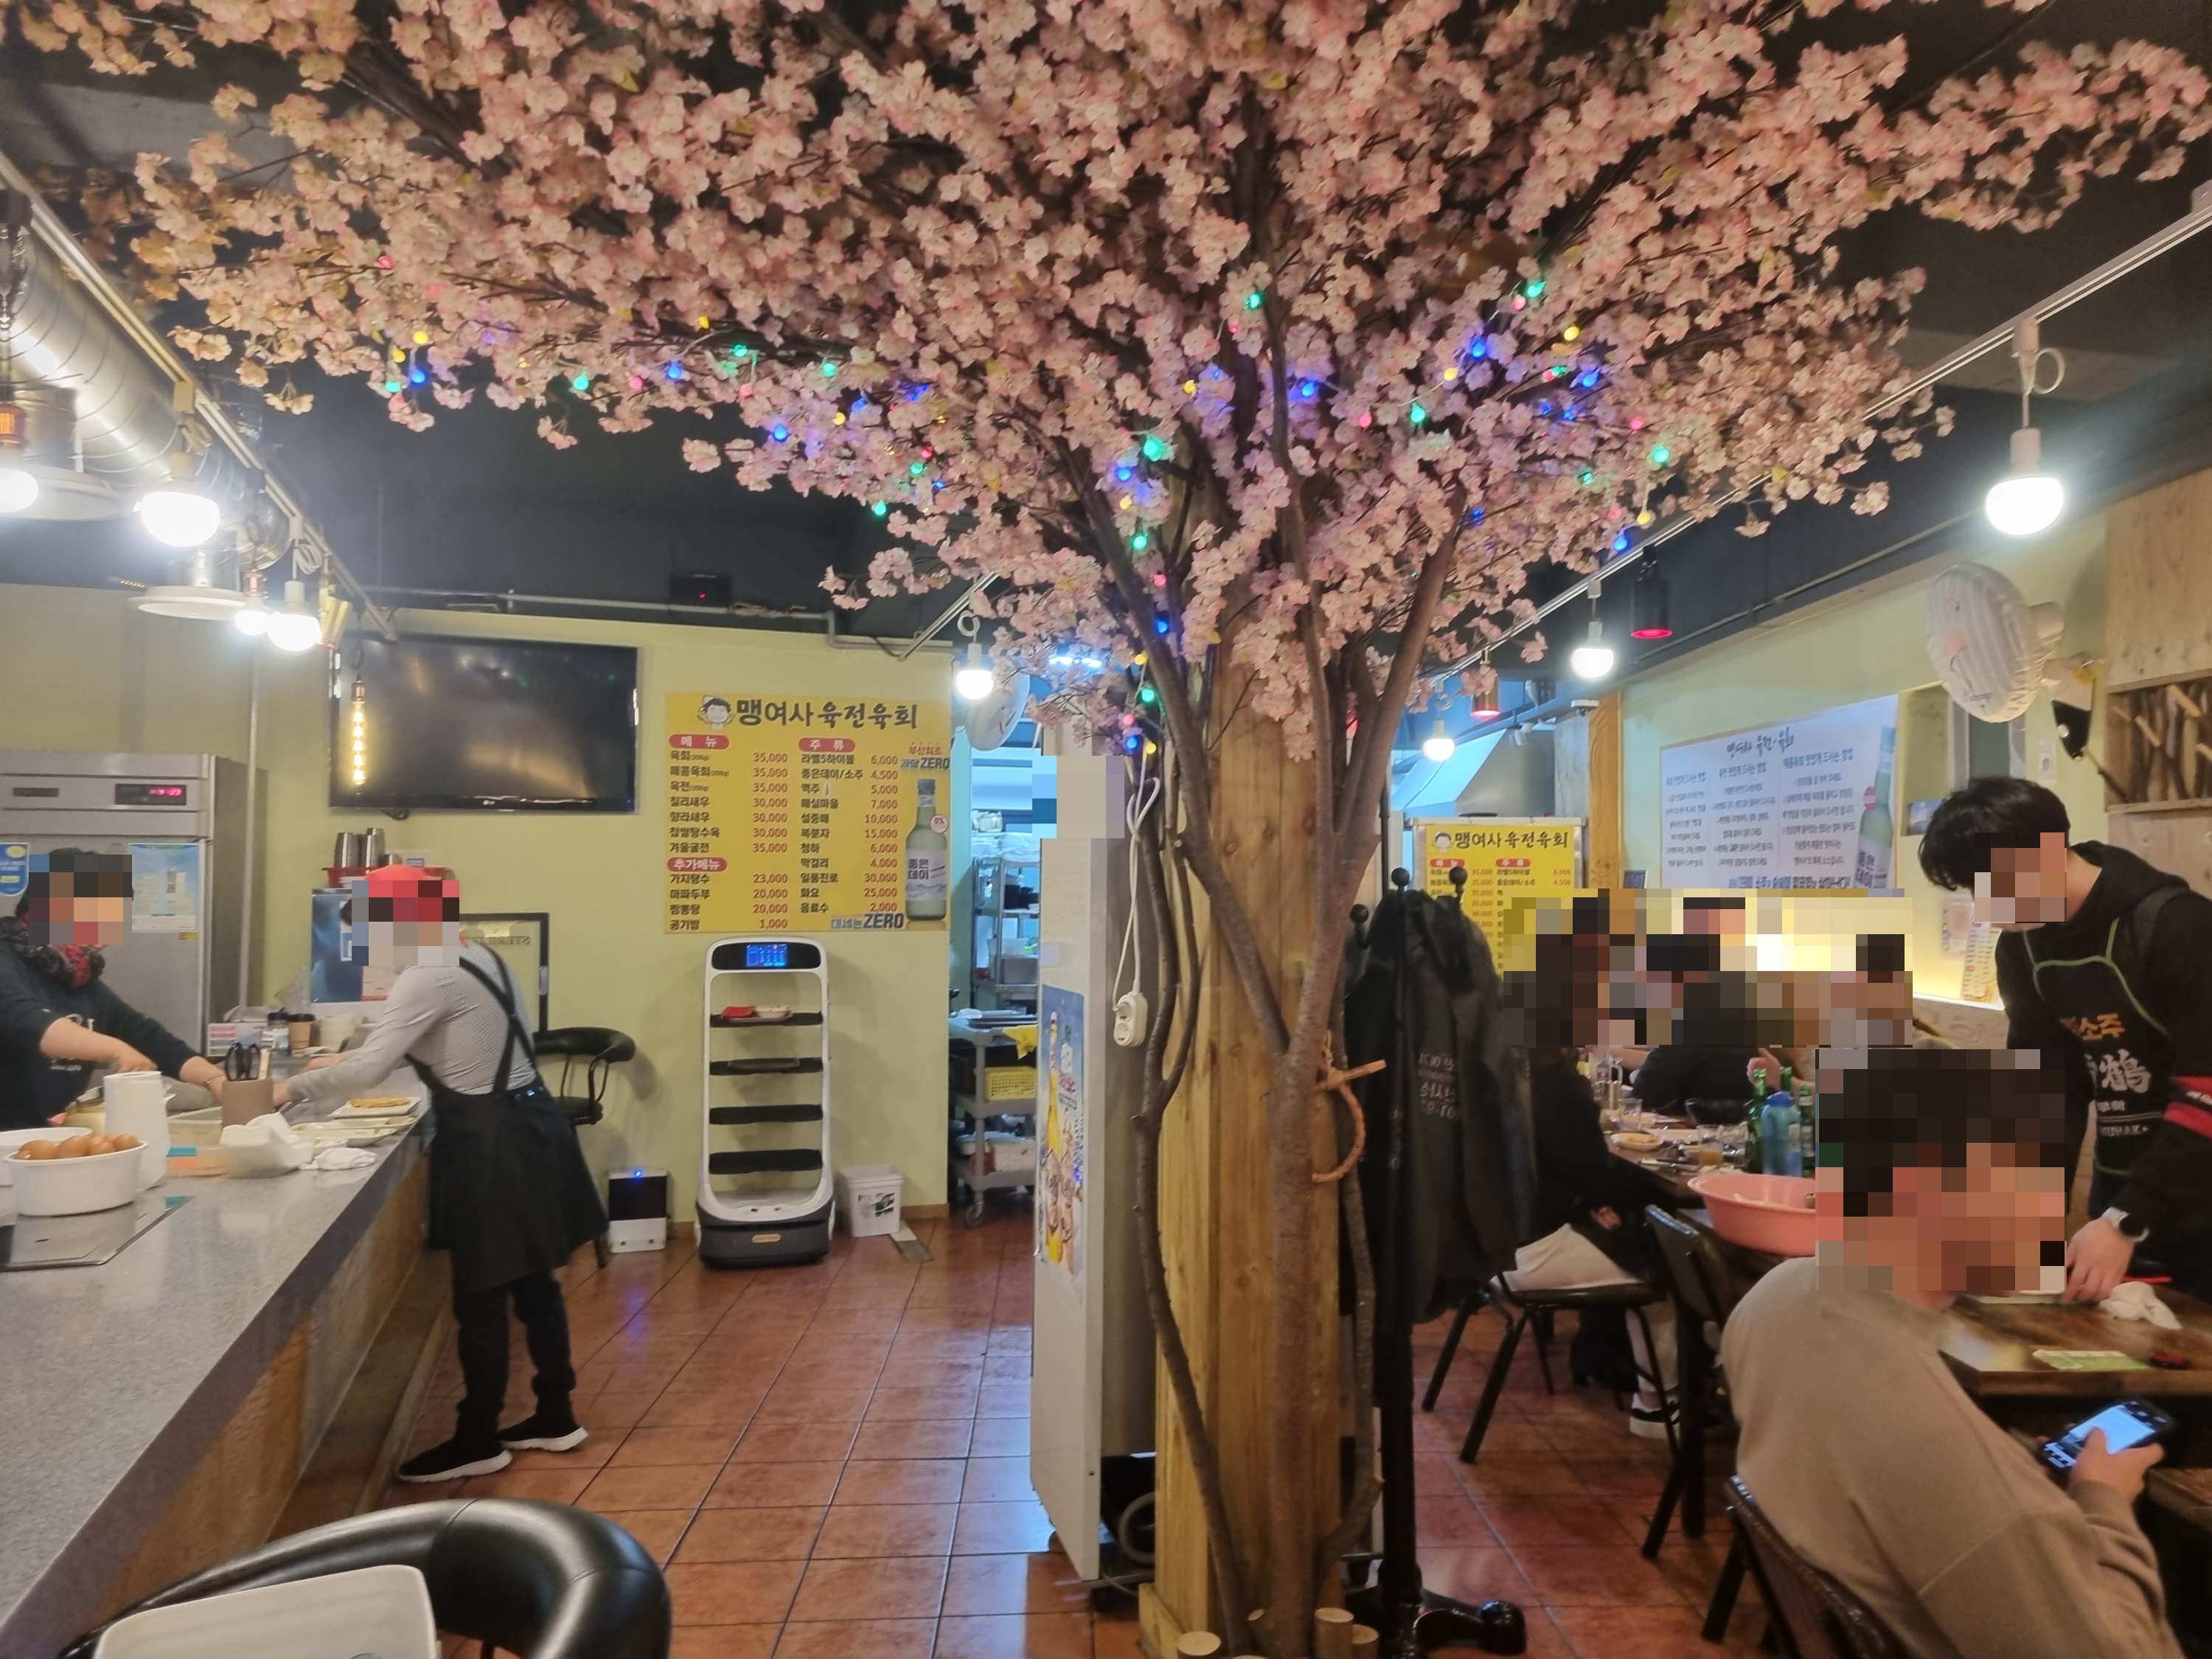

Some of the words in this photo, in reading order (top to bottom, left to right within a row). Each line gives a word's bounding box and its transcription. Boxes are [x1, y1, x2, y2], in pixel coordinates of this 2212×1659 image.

[737, 699, 814, 727] 맹여사
[817, 701, 917, 729] 육전육회
[753, 753, 787, 763] 35,000
[871, 755, 898, 766] 6,000
[753, 768, 787, 778] 35,000
[801, 769, 863, 780] 좋은데이/소주
[871, 771, 898, 781] 4,500
[753, 782, 787, 793] 35,000
[801, 783, 820, 793] 맥주
[871, 785, 898, 796] 5,000
[753, 797, 787, 808] 30,000
[871, 800, 898, 810] 7,000
[753, 813, 787, 823] 30,000
[864, 814, 898, 824] 10,000
[753, 828, 787, 838] 30,000
[801, 828, 830, 839] 복분자
[864, 829, 898, 840] 15,000
[1455, 831, 1500, 849] 맹여사
[1504, 831, 1568, 849] 육전육회
[753, 843, 787, 853] 35,000
[801, 843, 820, 854] 청하
[870, 844, 898, 855] 6,000
[801, 858, 829, 869] 막걸리
[870, 858, 898, 869] 4,000
[753, 874, 788, 884] 23,000
[864, 873, 898, 884] 30,000
[669, 888, 711, 900] 마파두부
[753, 888, 788, 900] 20,000
[864, 888, 898, 899] 25,000
[753, 904, 788, 914] 20,000
[800, 902, 829, 914] 음료수
[870, 902, 898, 913] 2,000
[669, 919, 700, 931] 공기밥
[759, 919, 787, 930] 1,000
[863, 914, 905, 929] ZERO
